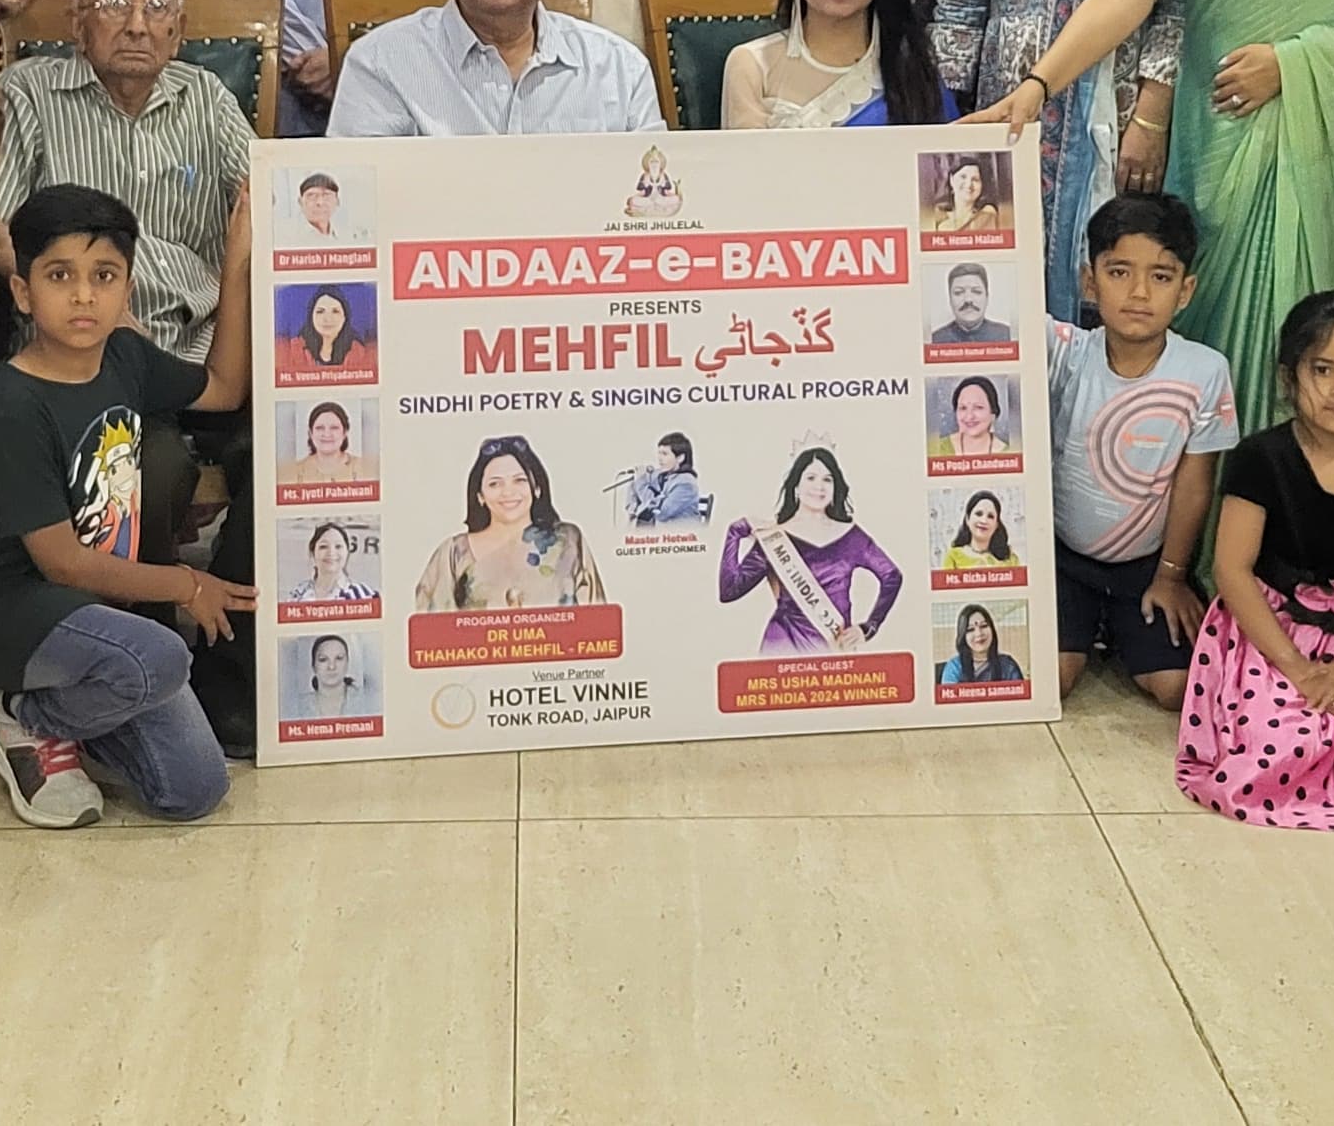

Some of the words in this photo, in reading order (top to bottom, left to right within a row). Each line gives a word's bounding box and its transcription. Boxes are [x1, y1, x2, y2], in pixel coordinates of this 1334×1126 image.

[604, 223, 621, 232] JAI
[622, 221, 648, 231] SHRI
[650, 219, 704, 230] JHULELAL
[279, 255, 290, 266] Dr
[408, 238, 896, 289] ANDAAZ-e-BAYAN
[609, 300, 702, 316] PRESENTS
[463, 322, 682, 375] MEHFIL
[399, 395, 473, 414] SINDHI
[480, 391, 563, 411] POETRY
[569, 391, 586, 408] &
[591, 386, 683, 407] SINGING
[688, 382, 797, 403] CULTURAL
[802, 378, 909, 399] PROGRAM
[615, 547, 647, 556] GUEST
[649, 544, 707, 555] PERFORMER
[456, 614, 511, 627] PROGRAM
[514, 612, 575, 624] ORGANIZER
[487, 629, 509, 642] DR
[513, 627, 546, 641] UMA
[415, 647, 489, 663] THAHAKO
[493, 645, 507, 659] KI
[511, 643, 565, 658] MEHFIL
[578, 640, 618, 654] FAME
[532, 670, 564, 681] Venue
[567, 668, 606, 680] Partner
[777, 662, 819, 673] SPECIAL
[821, 660, 855, 671] GUEST
[747, 677, 778, 691] MRS
[781, 675, 820, 689] USHA
[822, 672, 886, 686] MADNANI
[489, 686, 566, 707] HOTEL
[573, 681, 648, 702] VINNIE
[736, 693, 766, 706] MRS
[770, 691, 807, 705] INDIA
[810, 689, 840, 703] 2024
[843, 686, 898, 700] WINNER
[487, 712, 532, 728] TONK
[537, 709, 588, 725] ROAD,
[593, 706, 651, 722] JAIPUR
